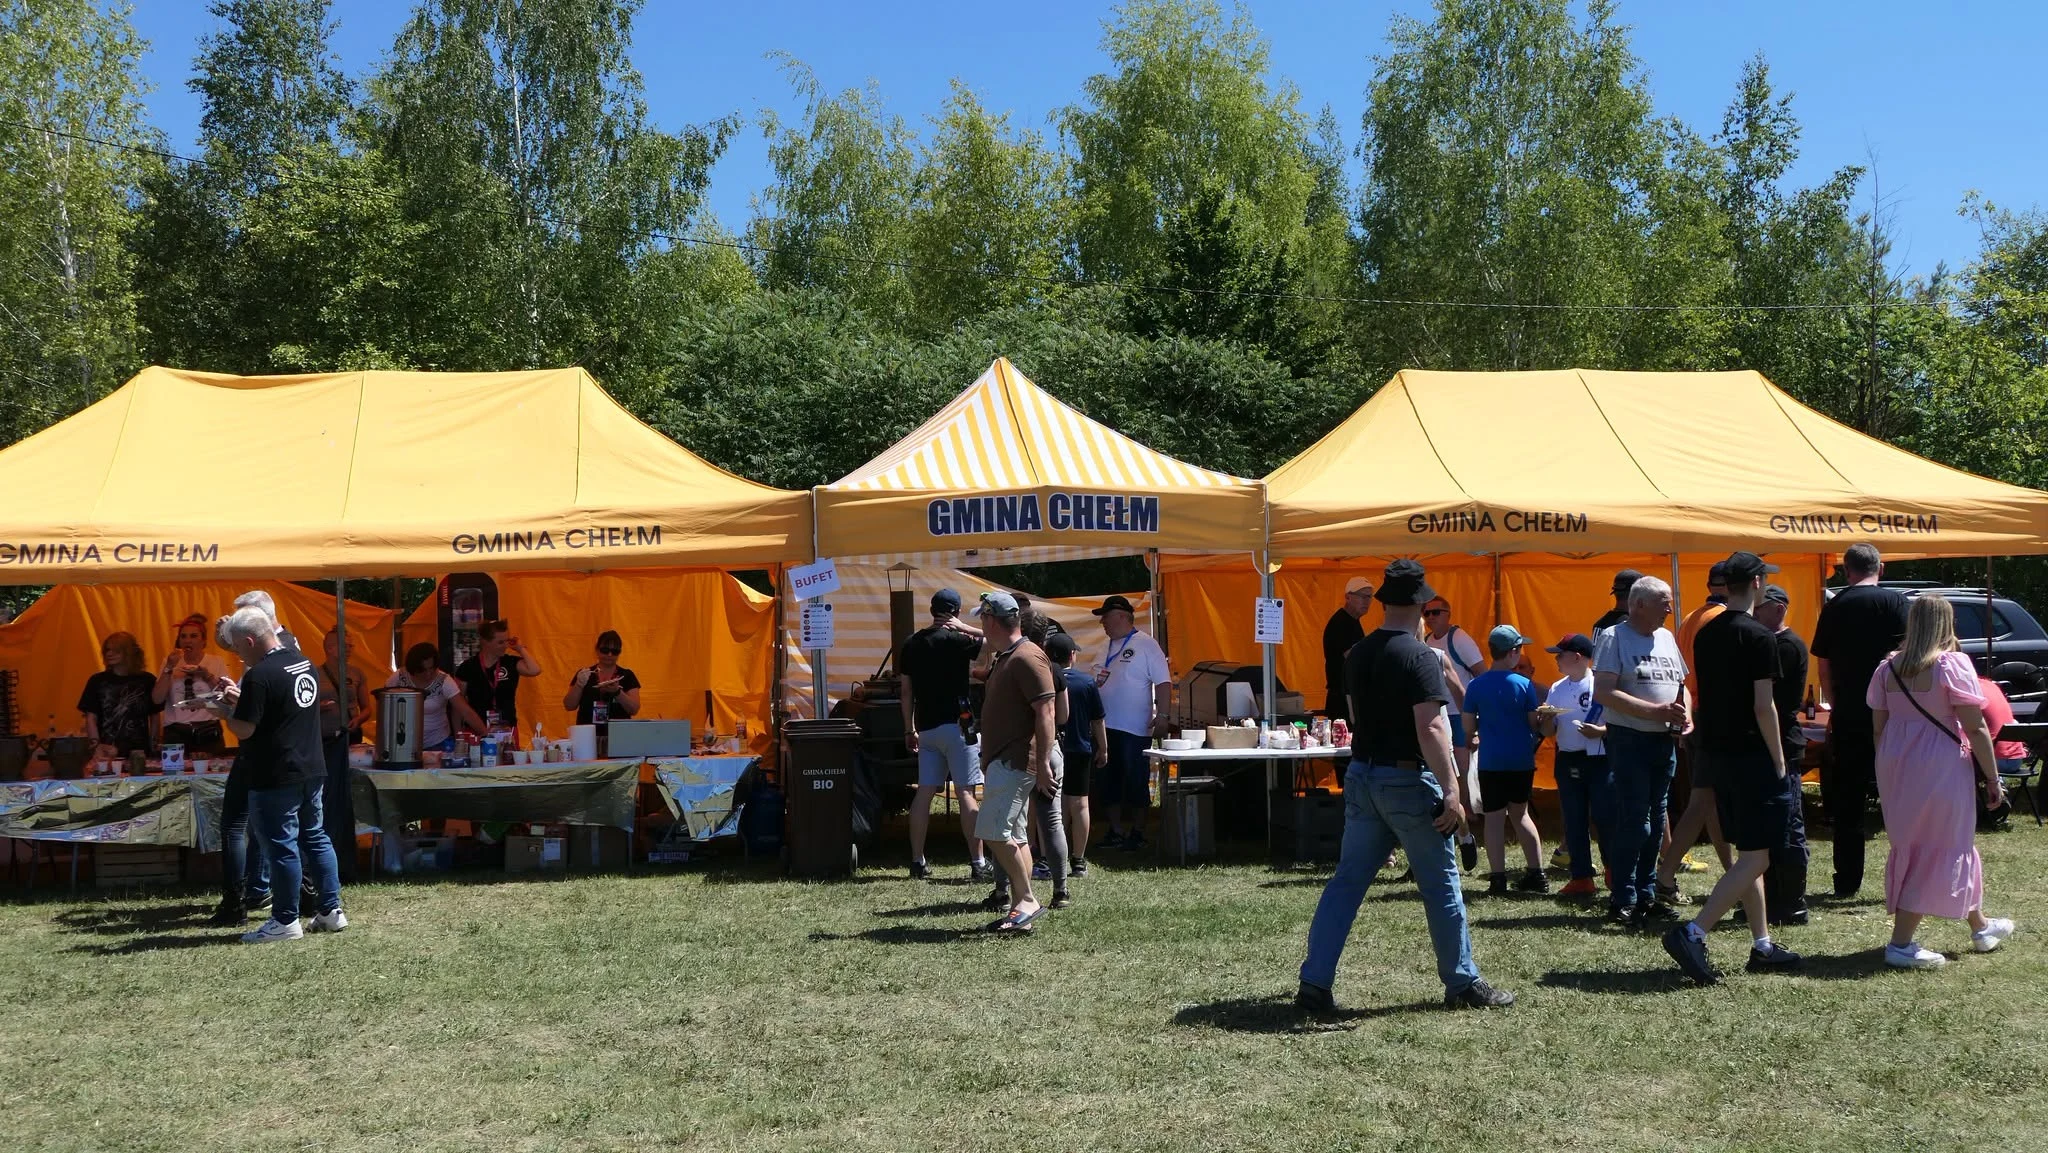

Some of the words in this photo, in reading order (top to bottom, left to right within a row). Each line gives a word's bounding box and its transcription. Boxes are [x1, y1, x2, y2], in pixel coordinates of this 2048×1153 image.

[928, 494, 1042, 536] GMINA
[1048, 493, 1159, 533] CHEŁM
[1407, 511, 1497, 534] GMINA
[1503, 511, 1588, 533] CHEŁM
[1769, 514, 1854, 534] GMINA
[1858, 514, 1938, 534] CHEŁM
[451, 530, 556, 554] GMINA
[565, 525, 661, 549] CHEŁM
[0, 543, 103, 565] GMINA
[113, 542, 219, 563] CHEŁM
[795, 570, 833, 588] BUFET
[813, 780, 834, 790] BIO
